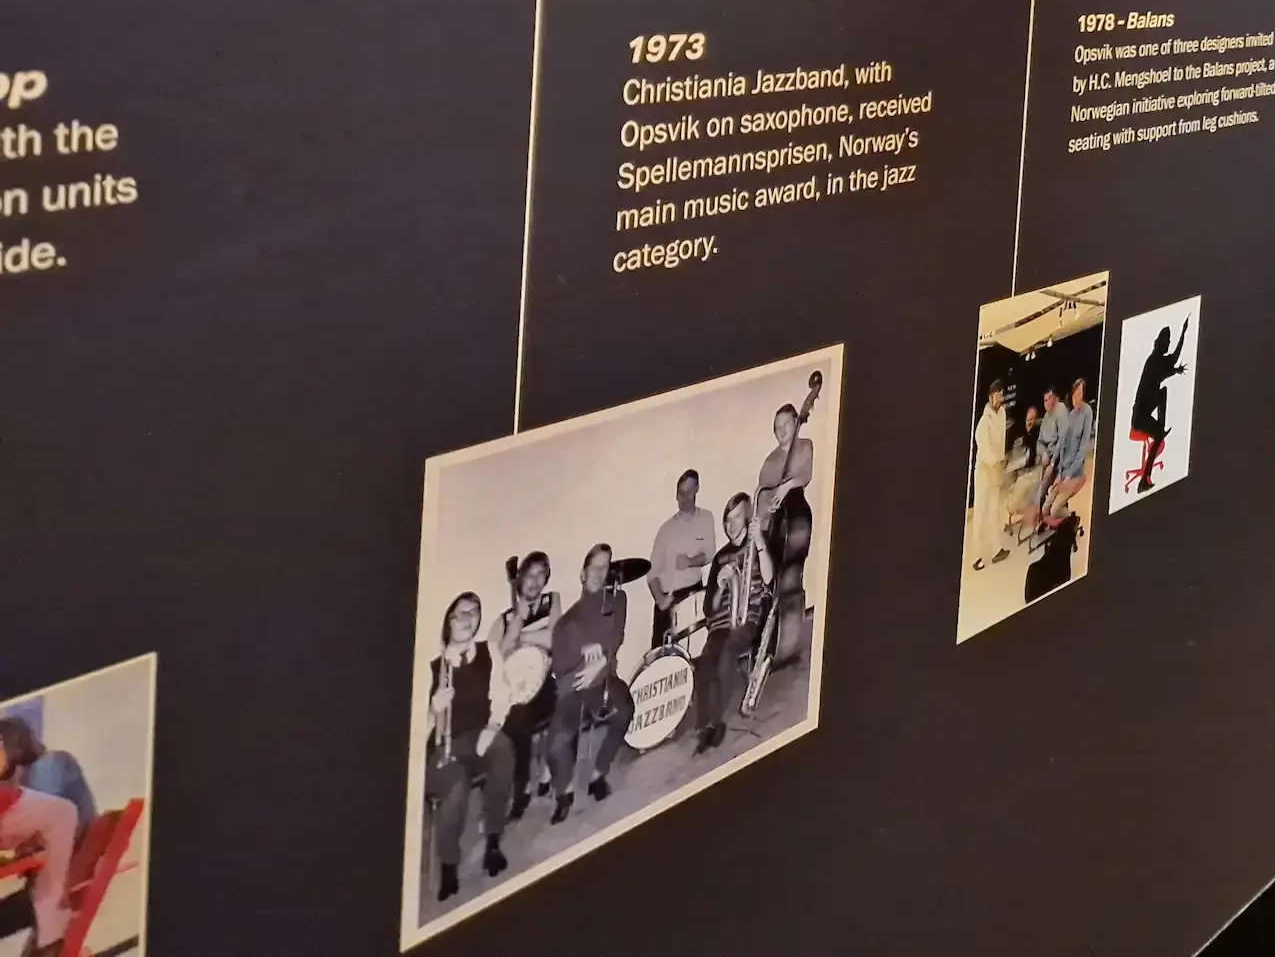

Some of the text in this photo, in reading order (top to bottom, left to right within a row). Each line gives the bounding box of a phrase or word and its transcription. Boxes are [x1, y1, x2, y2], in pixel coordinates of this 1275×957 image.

[1078, 12, 1174, 32] 1978 Balans
[629, 32, 706, 63] 1973
[1075, 32, 1274, 65] Opsvik was one of three designers invited
[623, 61, 891, 105] Christiania Jazzband, with
[1073, 58, 1275, 96] by H.C. Mengshoel to the Balans project, a
[621, 91, 931, 151] Opsvik on saxophone, received
[1071, 101, 1129, 122] Norwegian
[1132, 95, 1175, 114] initiative
[1177, 89, 1220, 109] exploring
[54, 120, 118, 153] the
[1068, 111, 1259, 152] seating with support from leg cushions.
[617, 128, 918, 192] Spellemannsprisen, Norway's
[43, 174, 137, 211] units
[617, 165, 916, 231] main music award, in the jazz
[612, 235, 718, 273] category.
